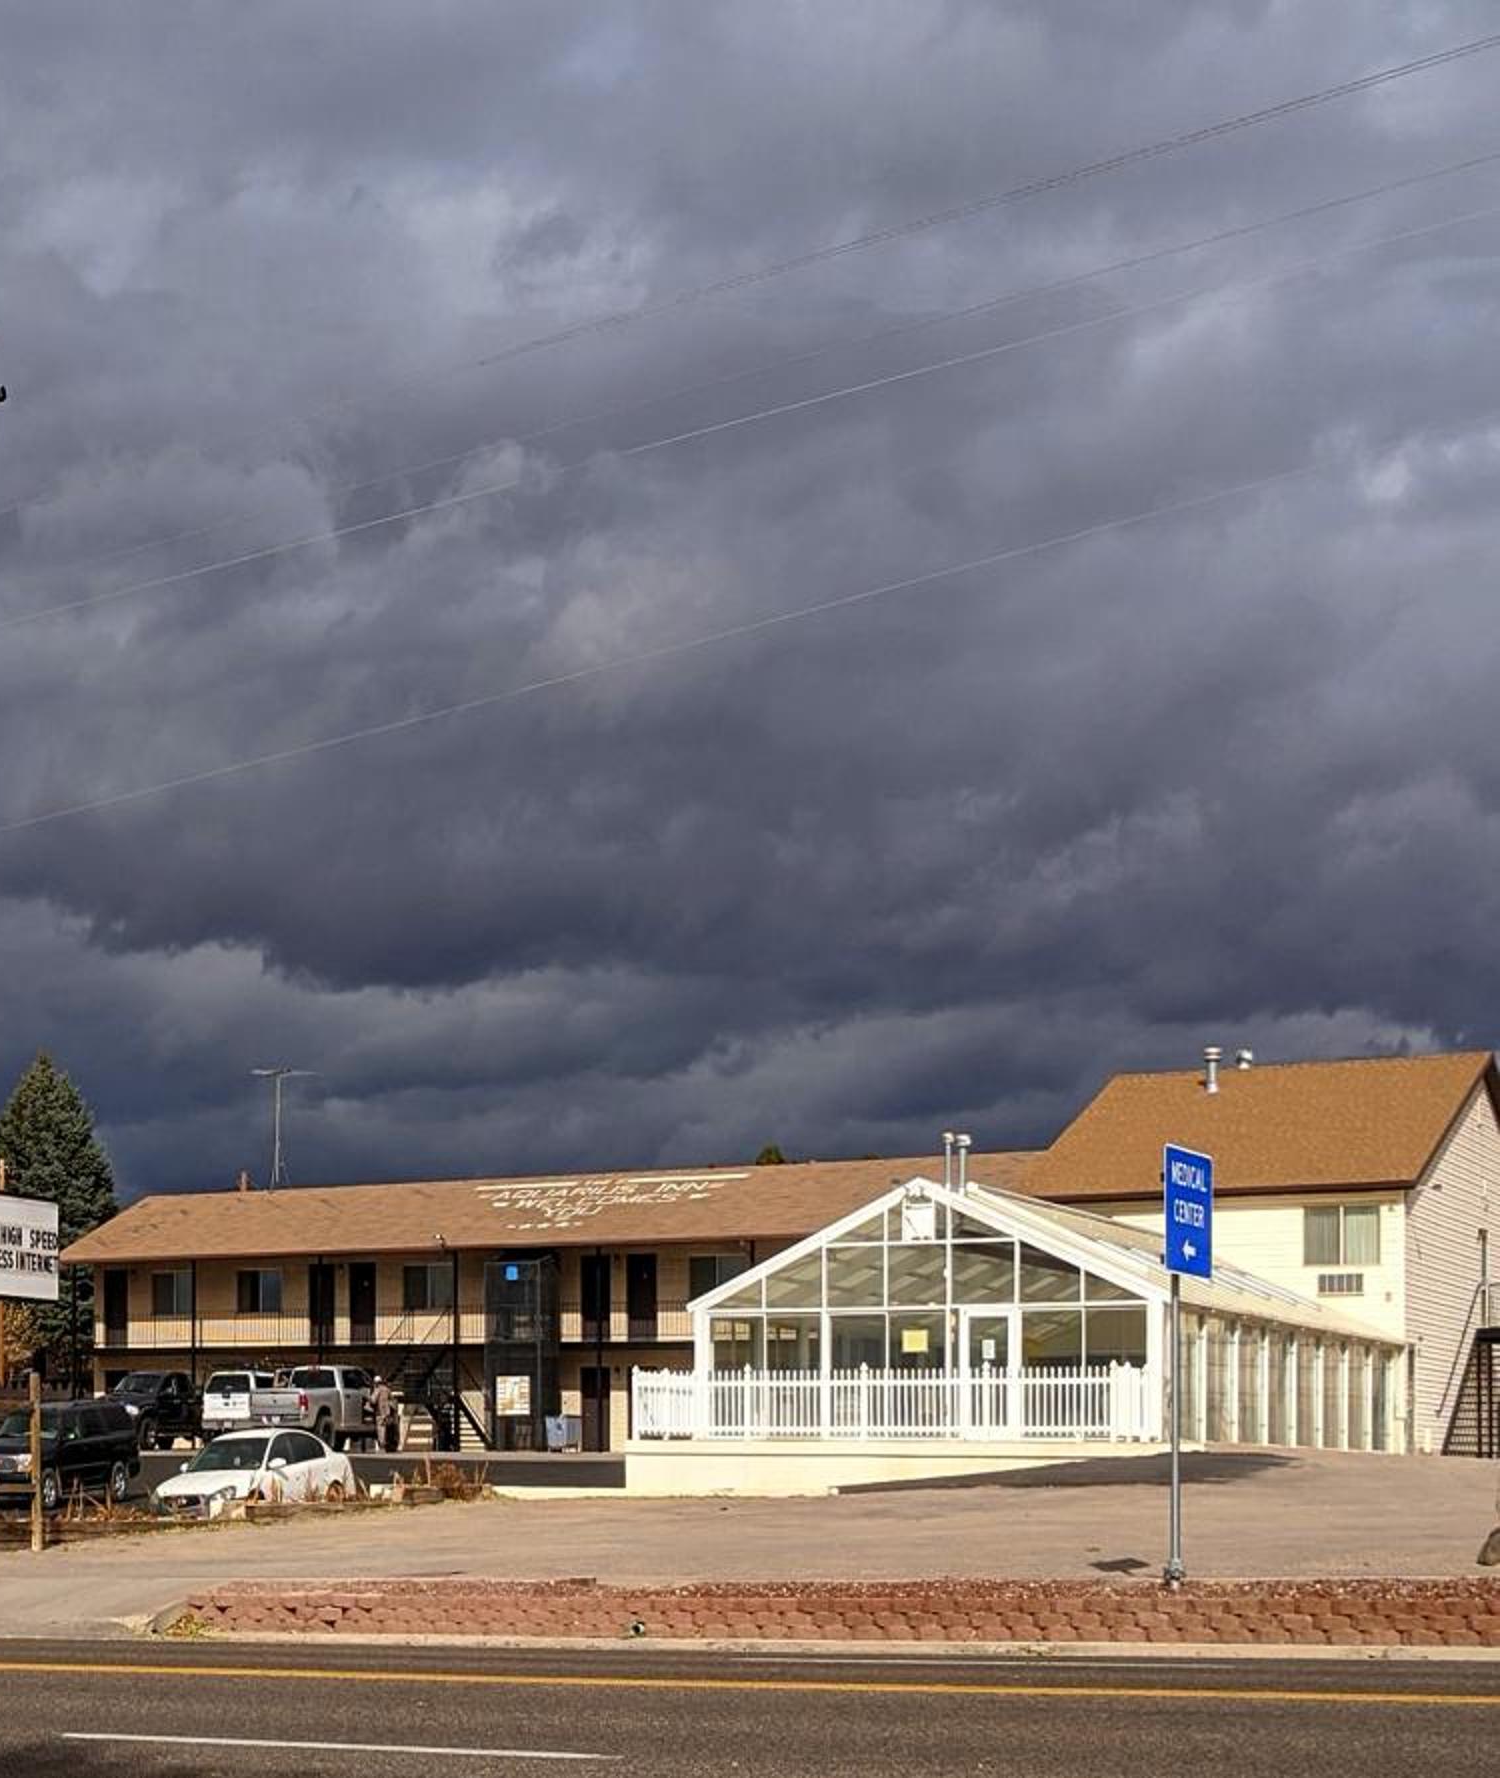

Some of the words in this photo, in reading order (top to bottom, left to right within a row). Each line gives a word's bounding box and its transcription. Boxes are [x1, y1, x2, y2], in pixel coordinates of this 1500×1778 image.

[654, 1181, 708, 1193] INN
[1171, 1160, 1208, 1192] MEDICAL
[1173, 1198, 1205, 1229] CENTER
[0, 1226, 23, 1247] HIGH
[29, 1229, 59, 1250] SPEED
[15, 1250, 59, 1275] INTERNET
